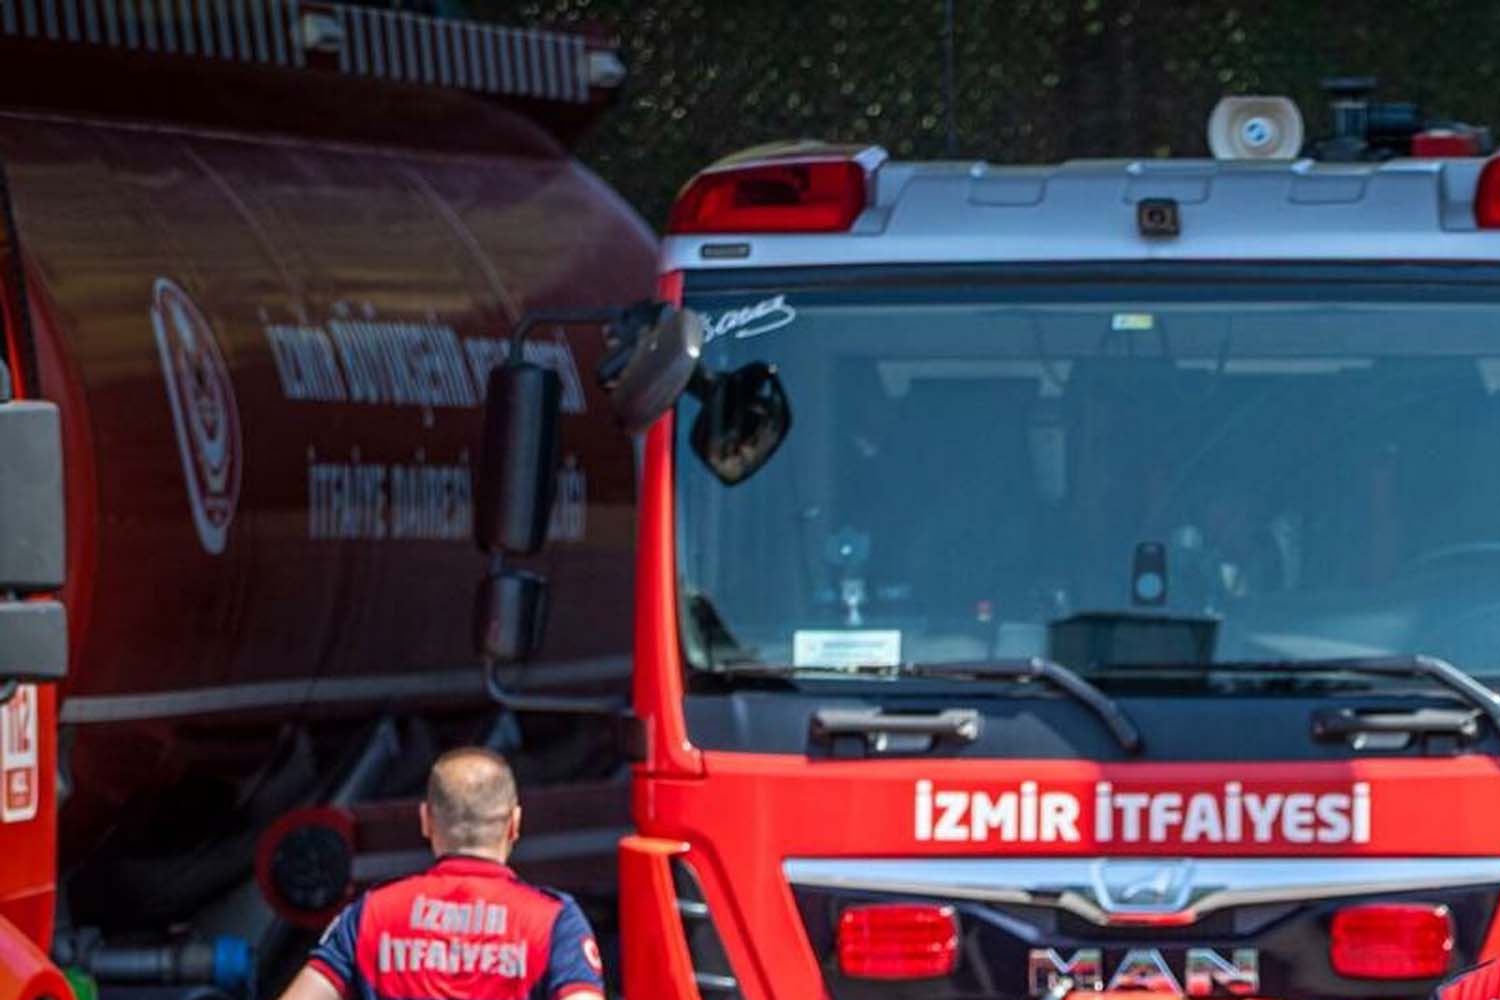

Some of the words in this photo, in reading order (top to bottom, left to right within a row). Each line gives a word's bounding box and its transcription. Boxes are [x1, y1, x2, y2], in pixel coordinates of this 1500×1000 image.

[914, 780, 1080, 842] İZMİR
[1095, 782, 1370, 843] İTFAİYESİ
[410, 893, 508, 934] İZMİR
[378, 932, 527, 979] İTFAİYESİ
[1029, 948, 1259, 999] MAN
